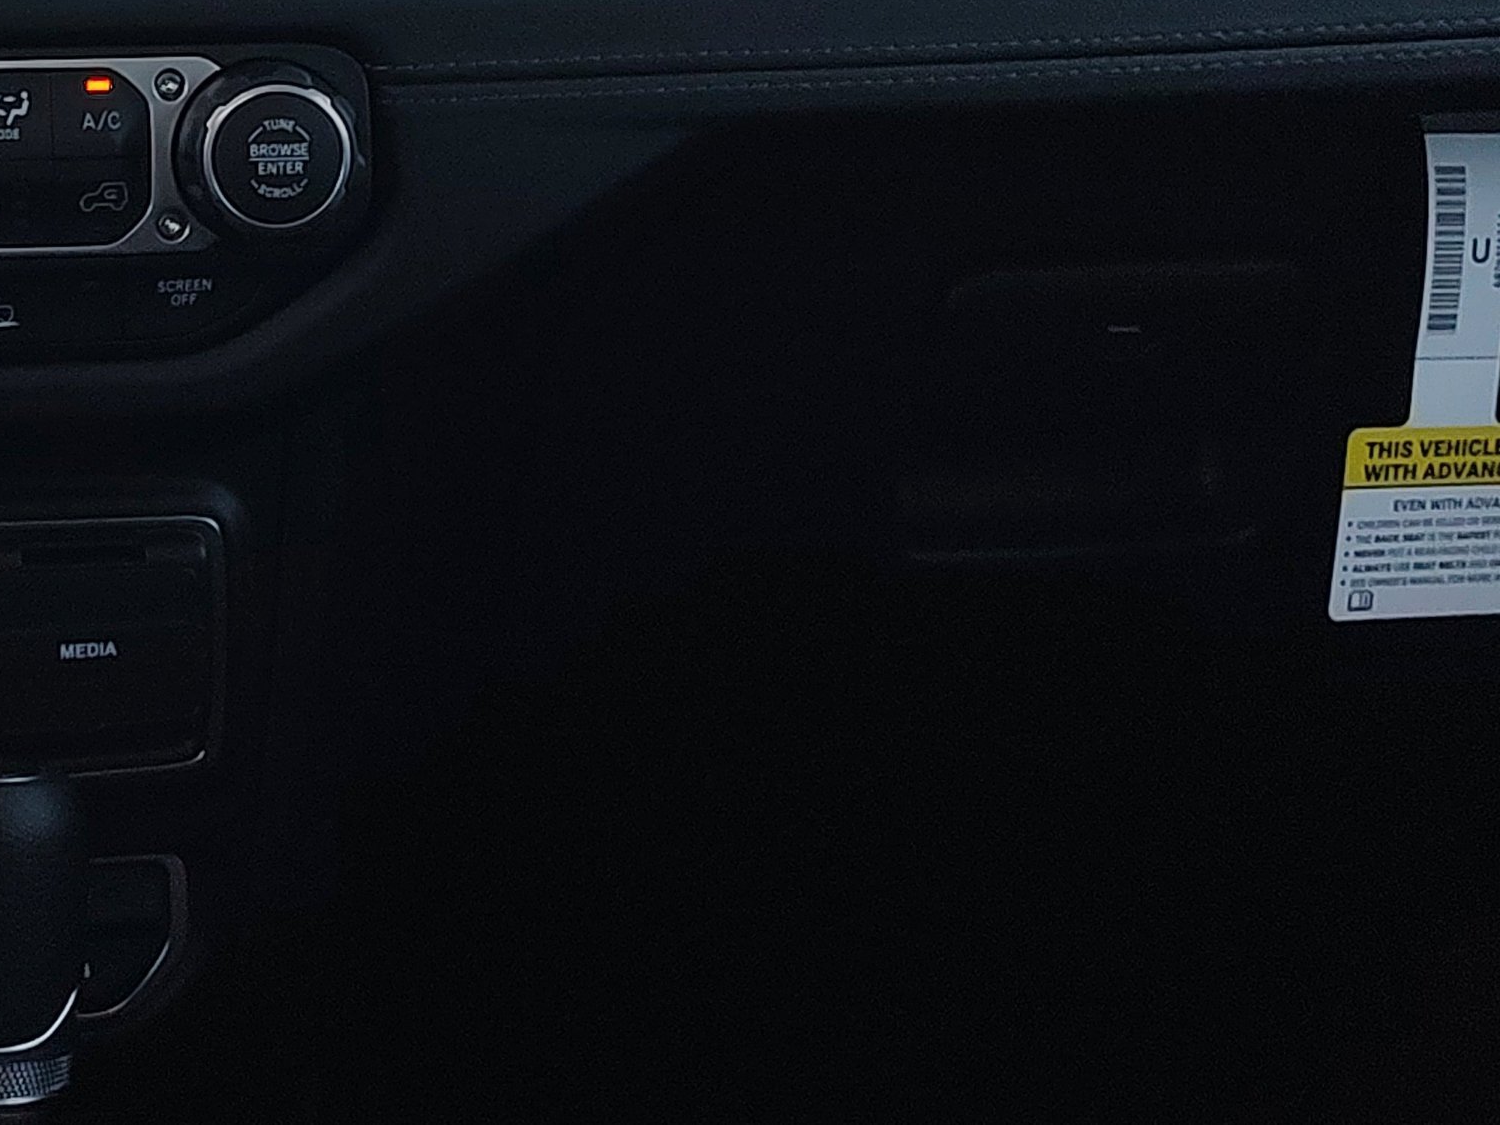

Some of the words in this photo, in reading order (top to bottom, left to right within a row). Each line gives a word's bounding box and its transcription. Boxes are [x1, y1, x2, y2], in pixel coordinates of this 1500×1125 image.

[81, 112, 122, 132] A/C
[262, 118, 297, 133] TUNE
[250, 142, 309, 157] BROWSE
[258, 161, 304, 175] ENTER
[258, 183, 304, 199] SCROLL
[157, 278, 213, 293] SCREEN
[170, 293, 197, 307] OFF
[1366, 441, 1413, 459] THIS
[1364, 463, 1417, 482] WITH
[1422, 460, 1500, 480] ADVAN
[1393, 499, 1426, 512] EVEN
[1431, 497, 1462, 510] WITH
[59, 642, 117, 660] MEDIA
